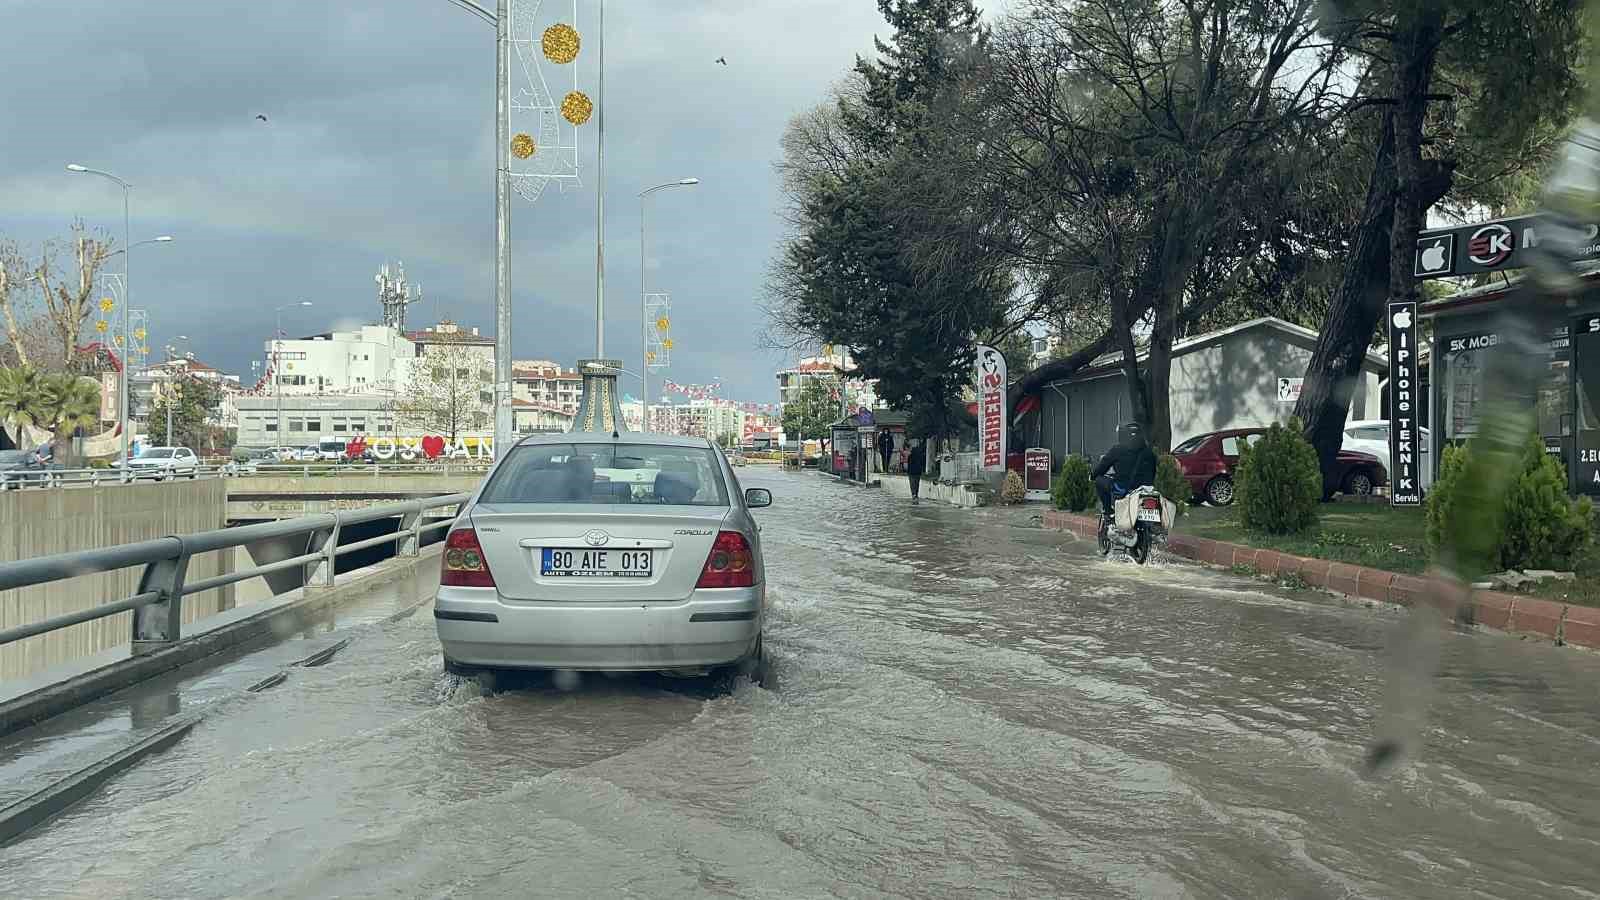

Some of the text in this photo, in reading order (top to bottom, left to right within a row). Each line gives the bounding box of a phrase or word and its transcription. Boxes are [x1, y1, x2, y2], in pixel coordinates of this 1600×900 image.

[1450, 338, 1465, 351] SK
[1395, 493, 1418, 502] Servis
[553, 551, 649, 570] 80 AIE 013
